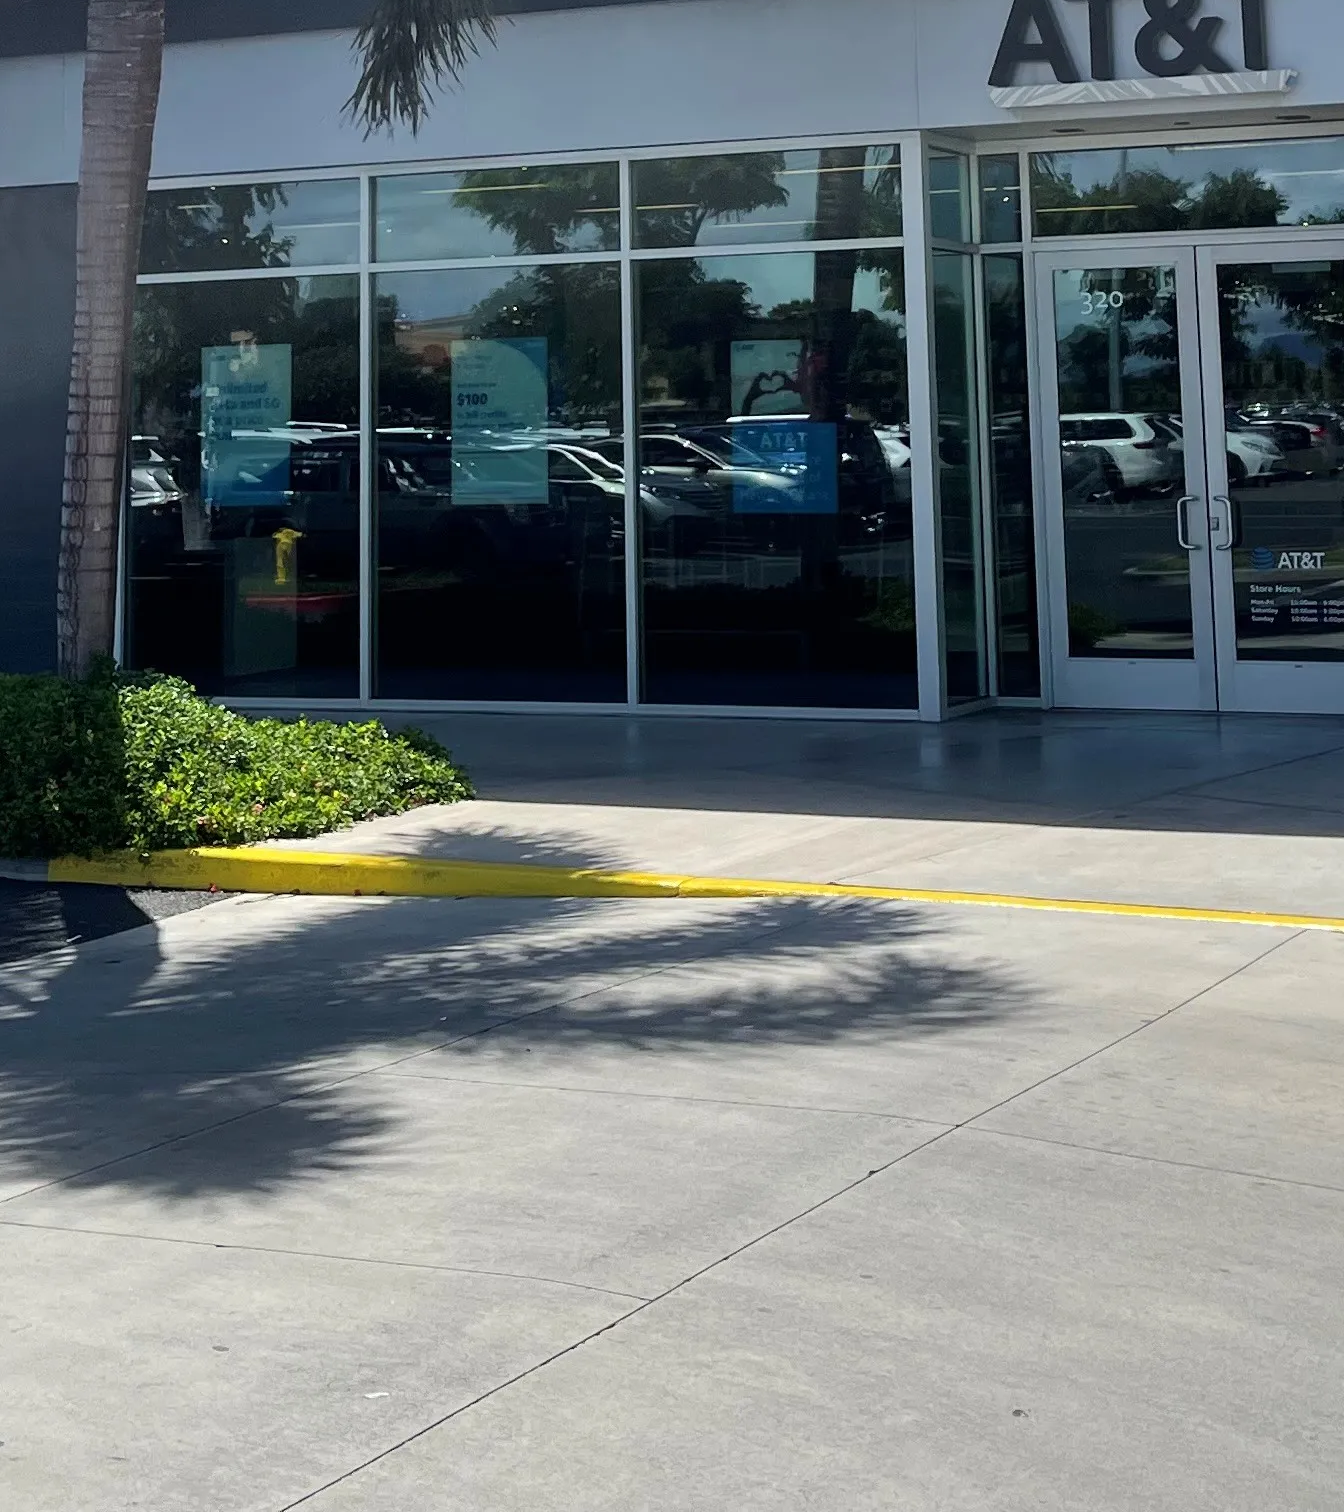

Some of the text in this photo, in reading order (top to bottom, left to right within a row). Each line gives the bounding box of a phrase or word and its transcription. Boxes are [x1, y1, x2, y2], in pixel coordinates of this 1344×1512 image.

[1080, 290, 1124, 315] 320
[457, 392, 488, 406] $100
[760, 432, 807, 449] AT&T
[1278, 552, 1325, 569] AT&T
[1250, 584, 1301, 593] Store Hours
